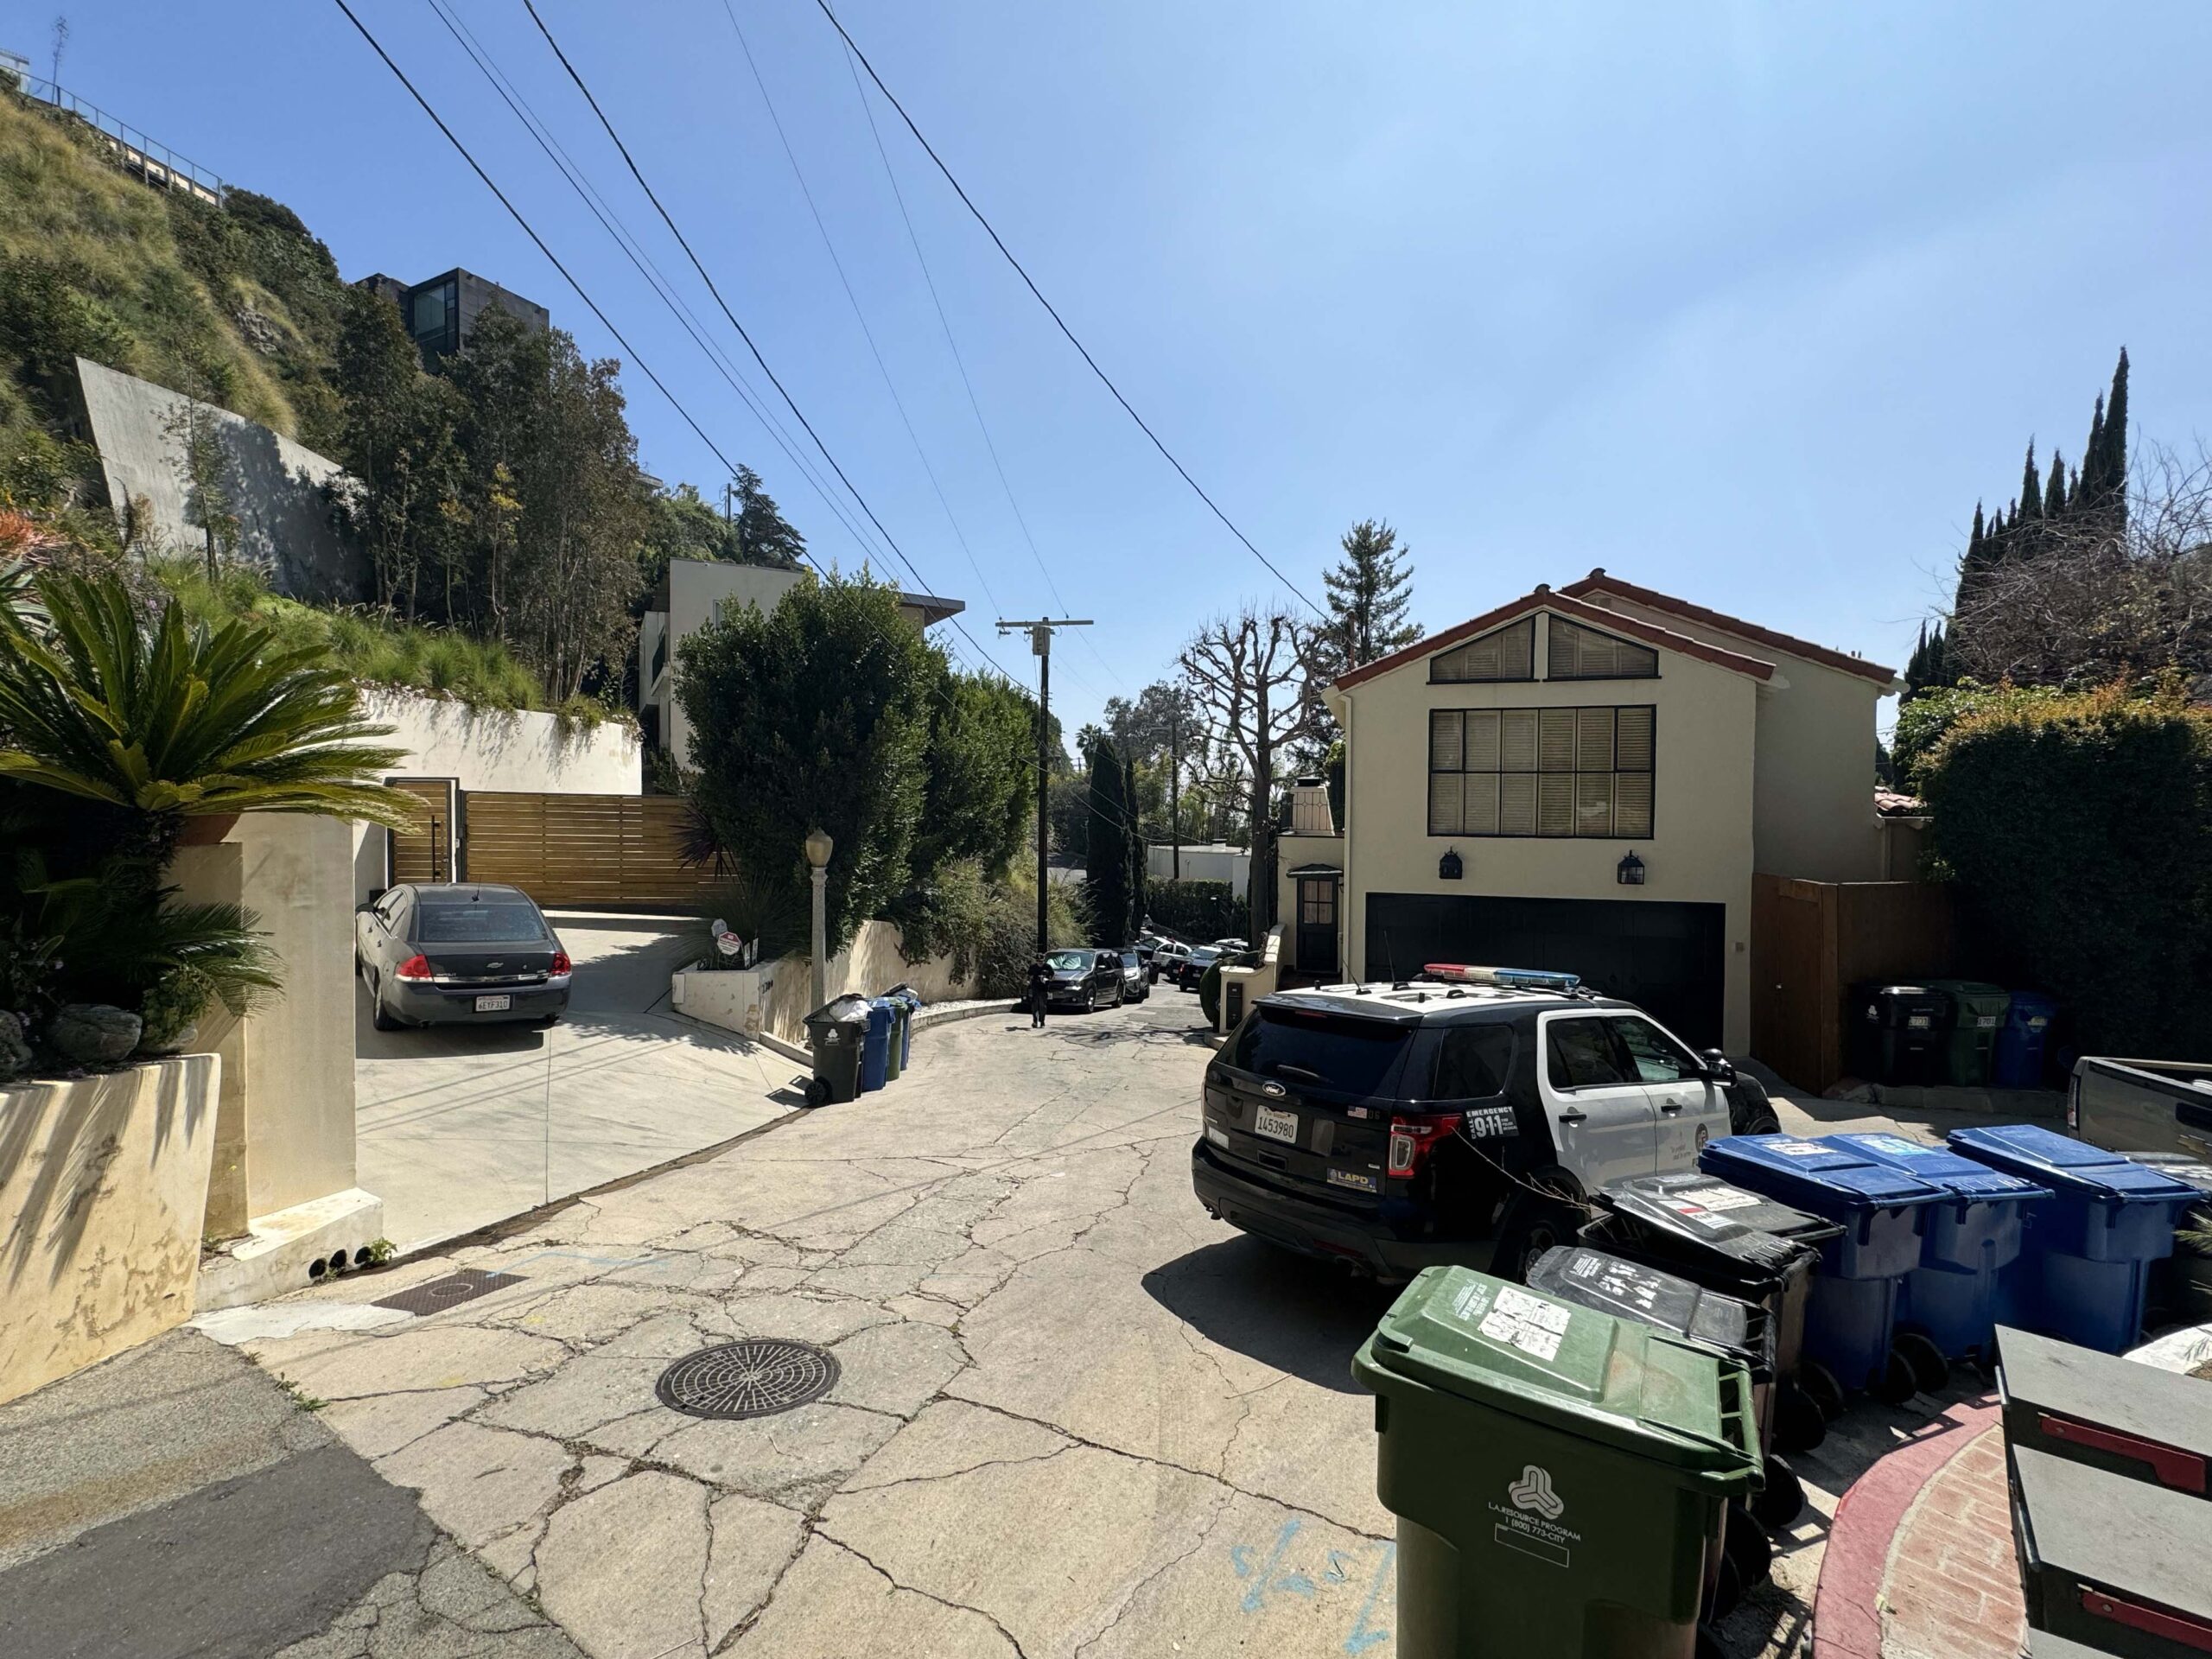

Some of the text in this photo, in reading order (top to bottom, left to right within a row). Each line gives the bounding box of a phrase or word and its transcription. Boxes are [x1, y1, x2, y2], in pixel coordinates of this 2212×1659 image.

[1466, 1106, 1512, 1117] EMERGENCY
[1257, 1116, 1294, 1138] 1453980
[1338, 1171, 1369, 1185] LAPD
[1510, 1518, 1530, 1533] (800)
[1532, 1526, 1566, 1544] 773-CITY
[1541, 1521, 1581, 1541] PROGRAM
